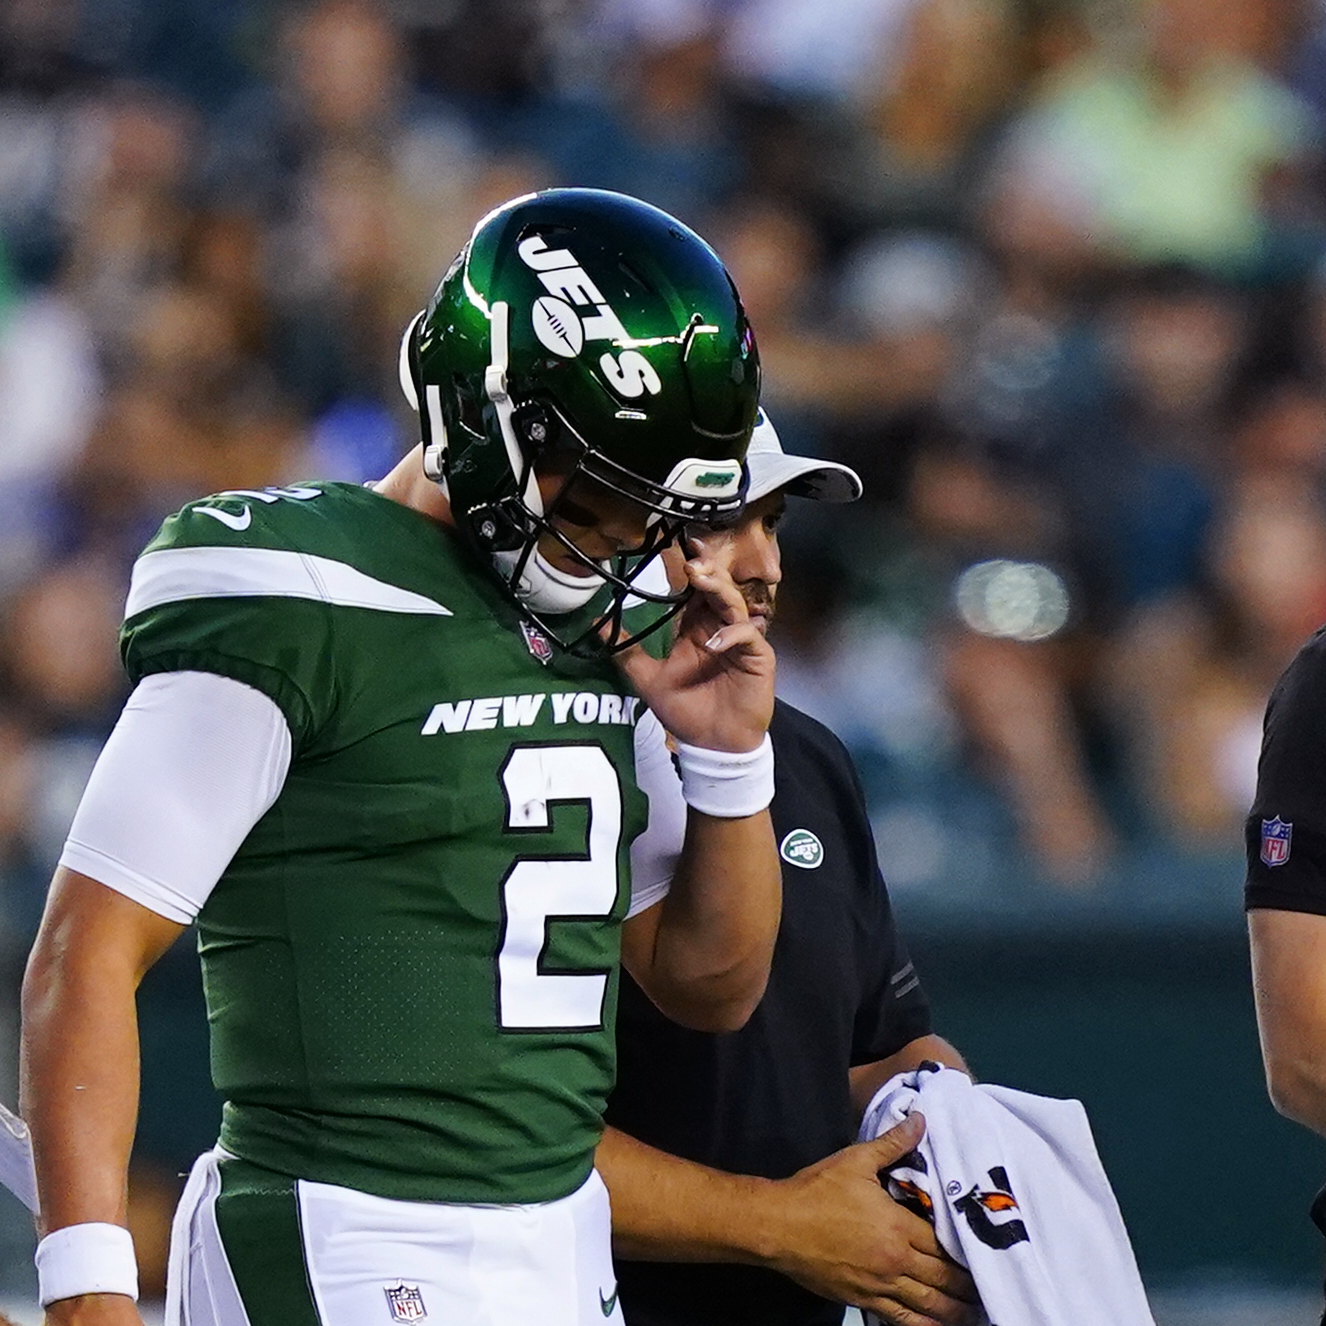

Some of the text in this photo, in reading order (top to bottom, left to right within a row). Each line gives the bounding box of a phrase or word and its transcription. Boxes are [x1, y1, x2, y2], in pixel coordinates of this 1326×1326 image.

[518, 235, 662, 398] JETS
[421, 693, 546, 735] NEW
[497, 739, 623, 1035] 2
[395, 1300, 423, 1317] NFL
